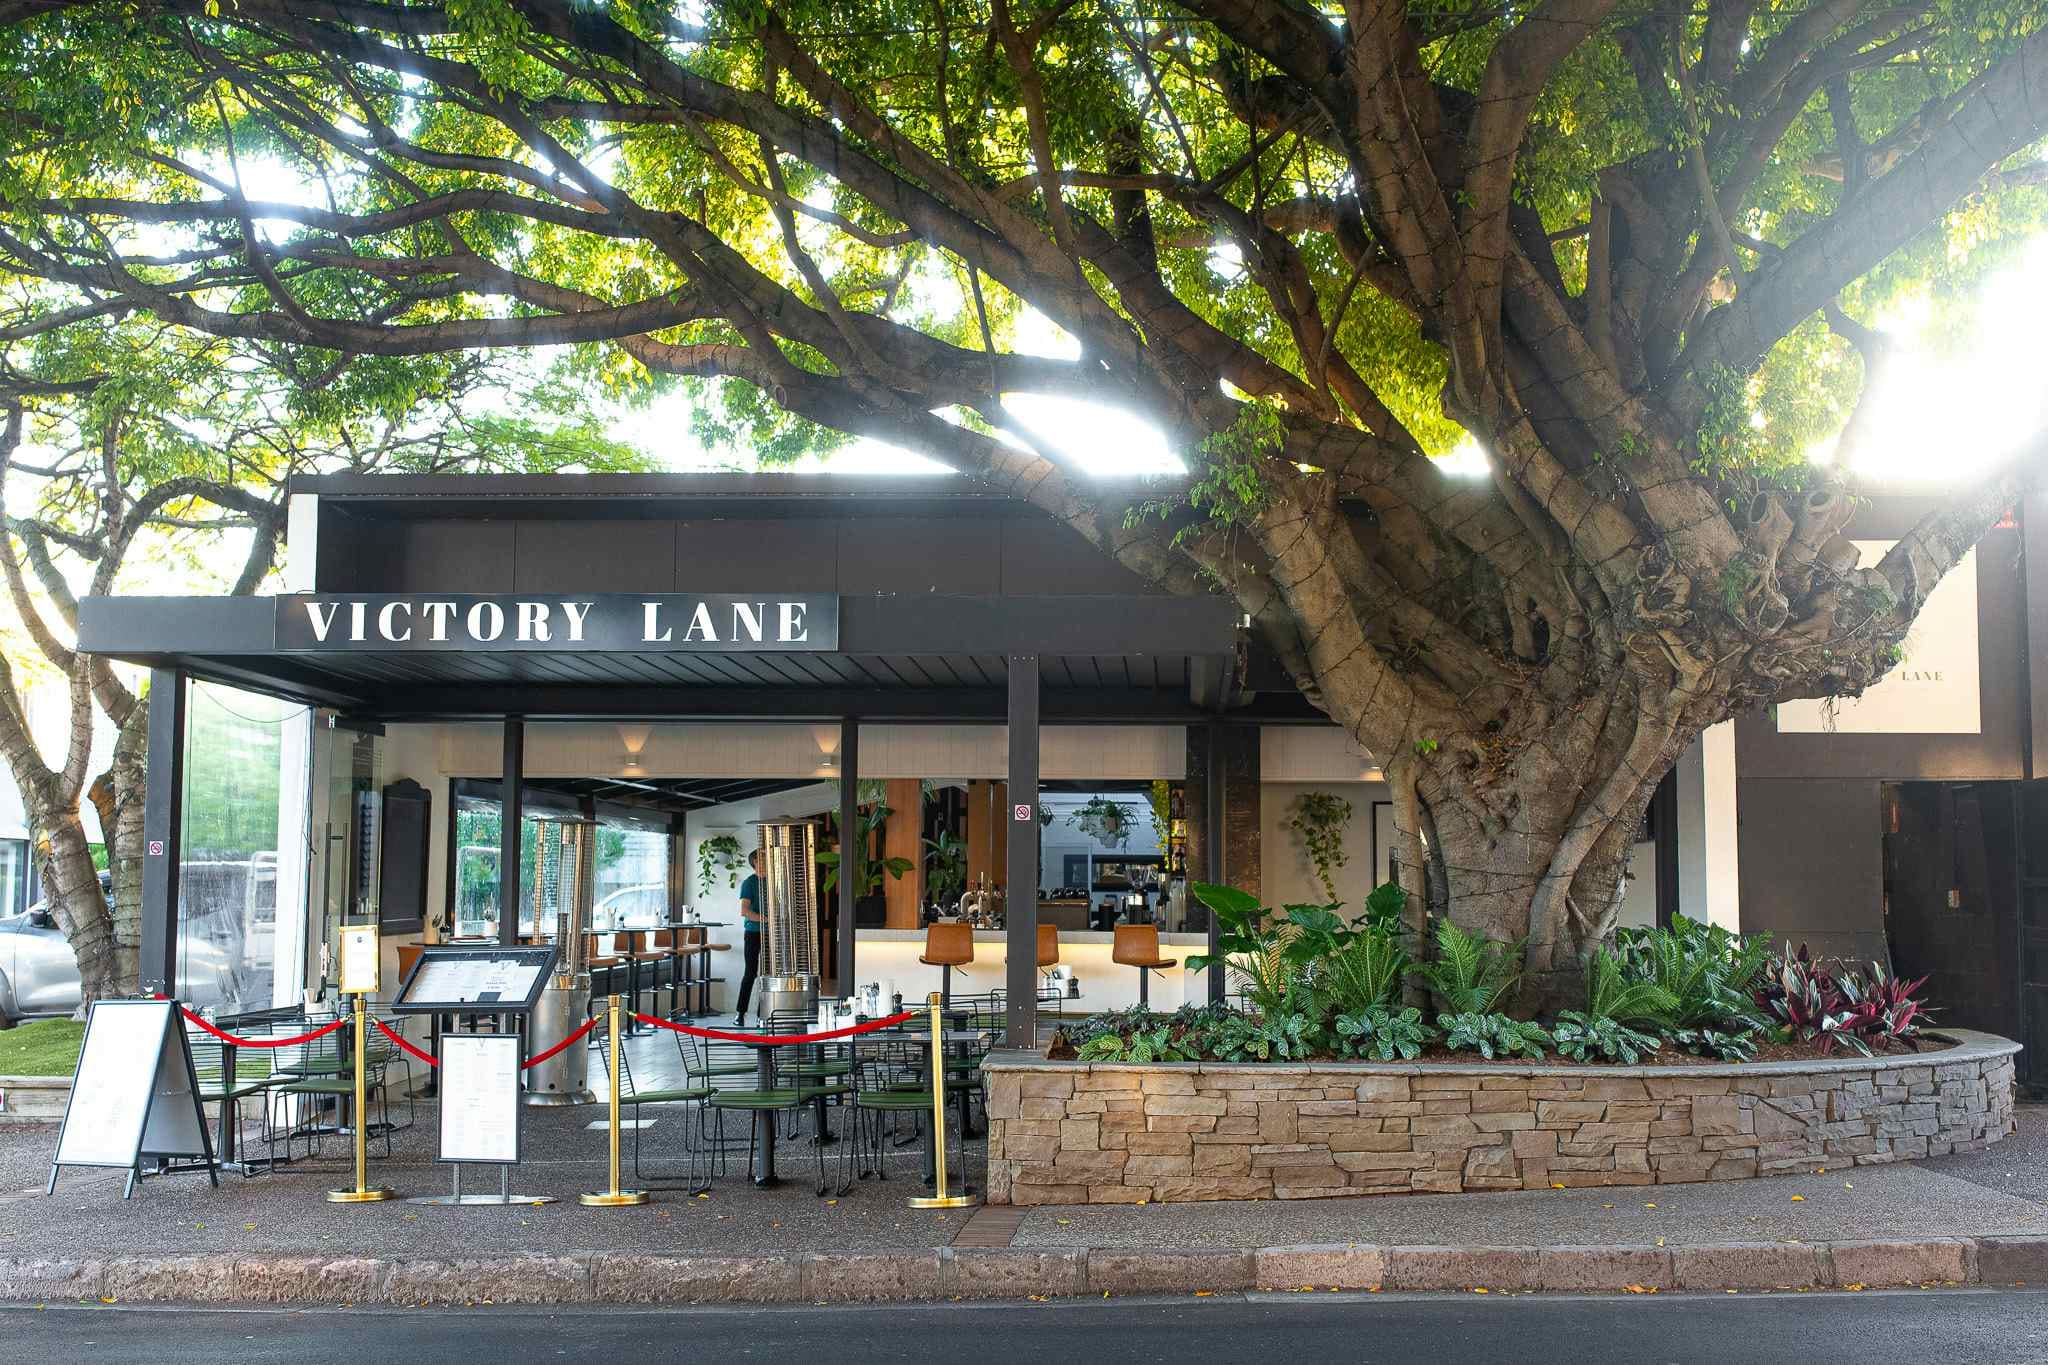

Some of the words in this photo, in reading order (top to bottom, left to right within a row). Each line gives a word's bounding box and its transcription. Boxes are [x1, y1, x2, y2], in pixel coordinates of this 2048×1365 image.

[304, 602, 593, 641] VICTORY
[642, 603, 807, 641] LANE
[1902, 671, 1943, 681] LANE
